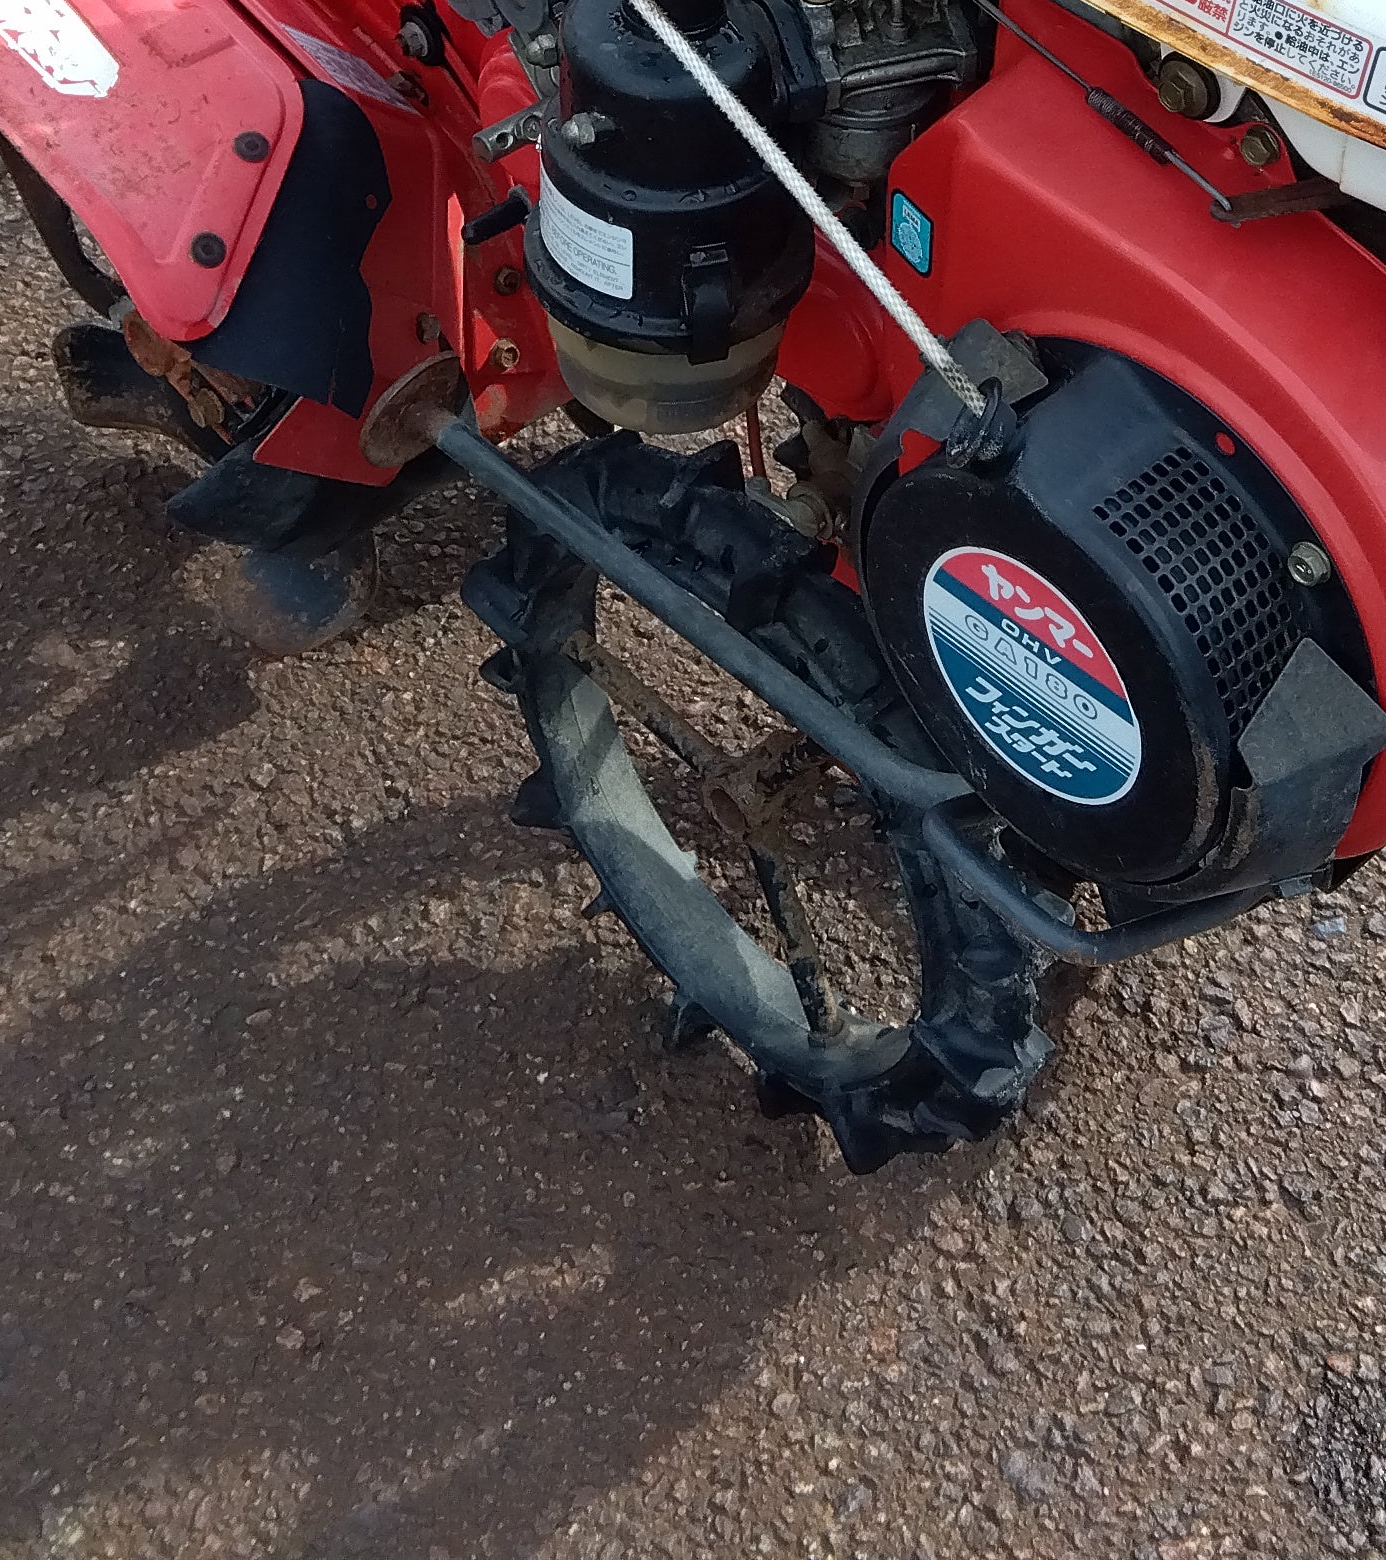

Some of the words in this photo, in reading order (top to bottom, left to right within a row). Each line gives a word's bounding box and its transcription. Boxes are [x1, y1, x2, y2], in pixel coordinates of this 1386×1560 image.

[1233, 22, 1356, 90] ジンを停止してください。
[981, 563, 1094, 659] ヤンマー
[1000, 617, 1062, 666] OHV
[964, 613, 1098, 720] GA180
[965, 676, 1097, 773] フィンガー
[984, 714, 1073, 778] スタート
